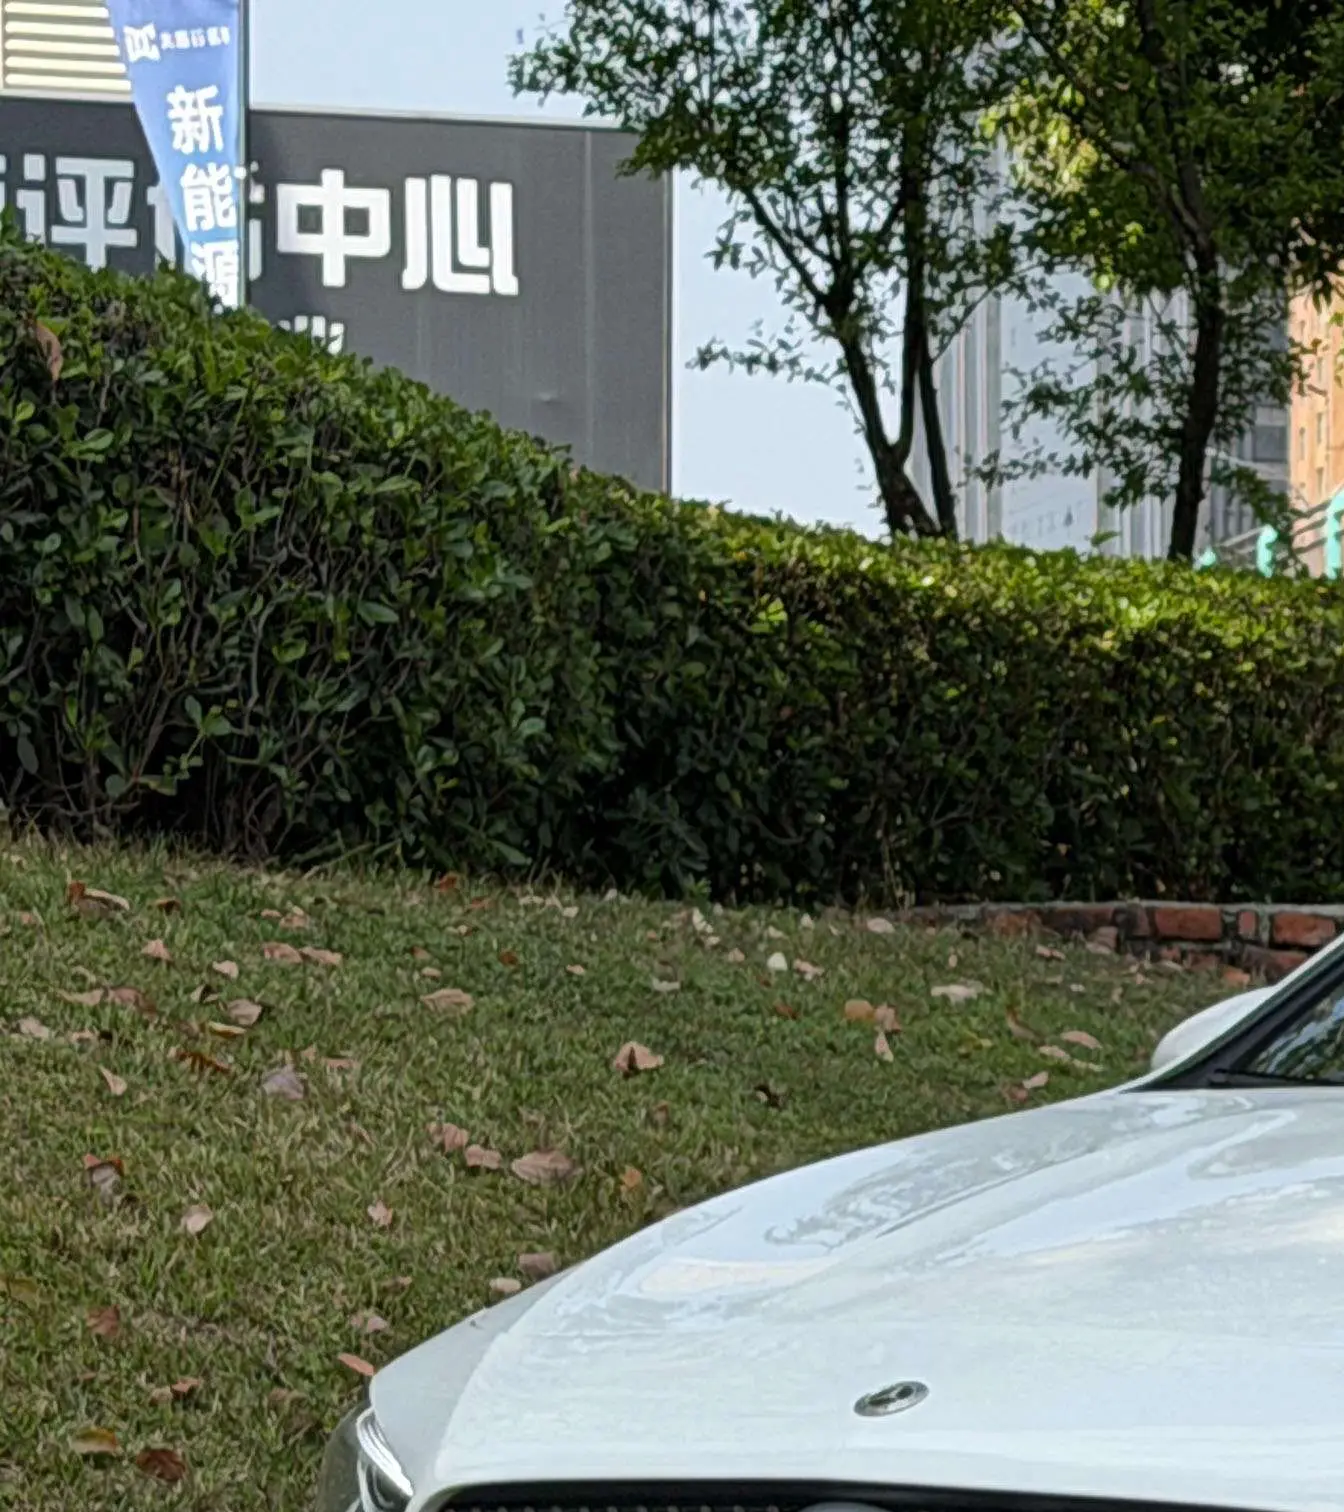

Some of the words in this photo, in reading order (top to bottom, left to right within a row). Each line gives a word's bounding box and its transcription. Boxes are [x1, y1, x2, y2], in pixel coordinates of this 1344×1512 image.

[0, 153, 518, 296] 评中心
[166, 84, 239, 309] 新能源
